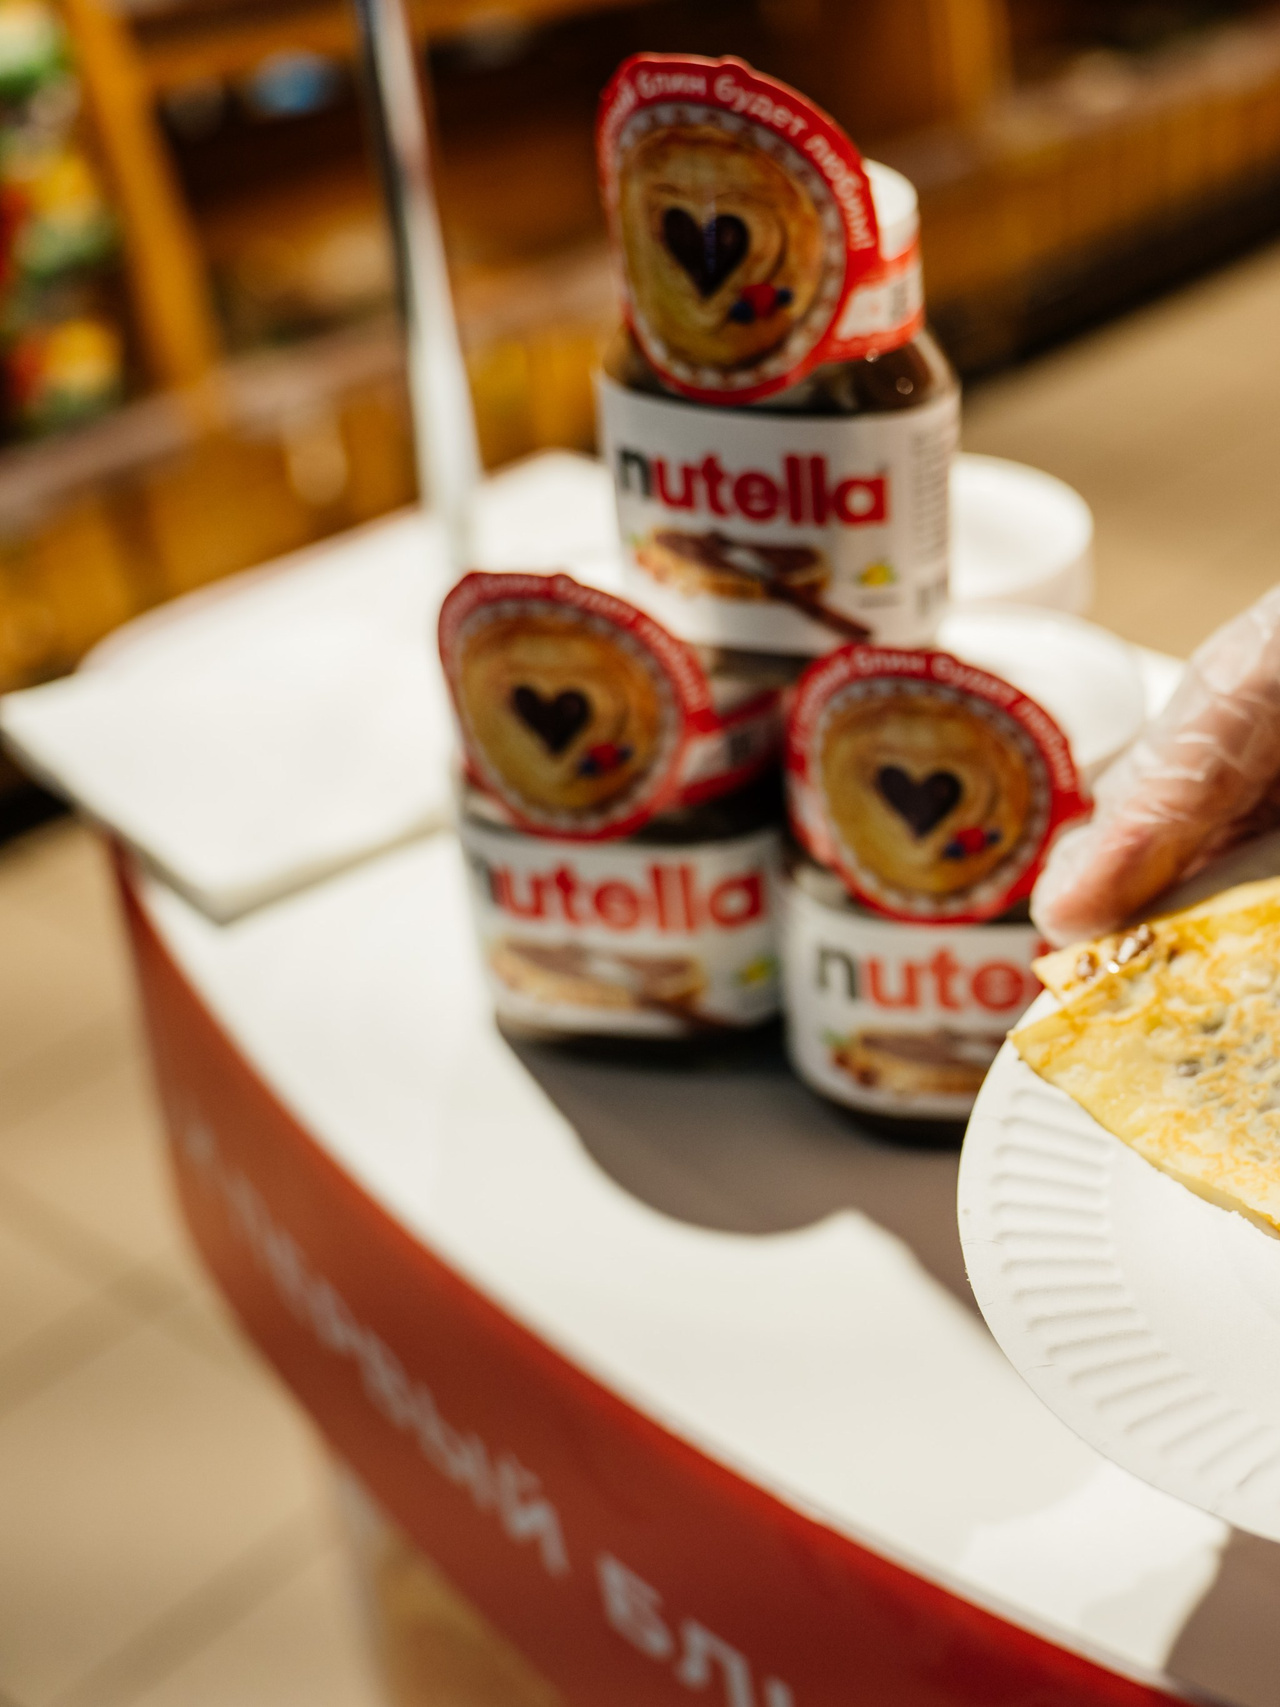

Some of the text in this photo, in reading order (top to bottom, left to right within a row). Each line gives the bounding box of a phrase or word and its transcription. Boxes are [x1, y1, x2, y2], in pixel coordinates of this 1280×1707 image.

[636, 69, 707, 99] блин
[714, 74, 809, 137] будет
[617, 445, 889, 526] nutella
